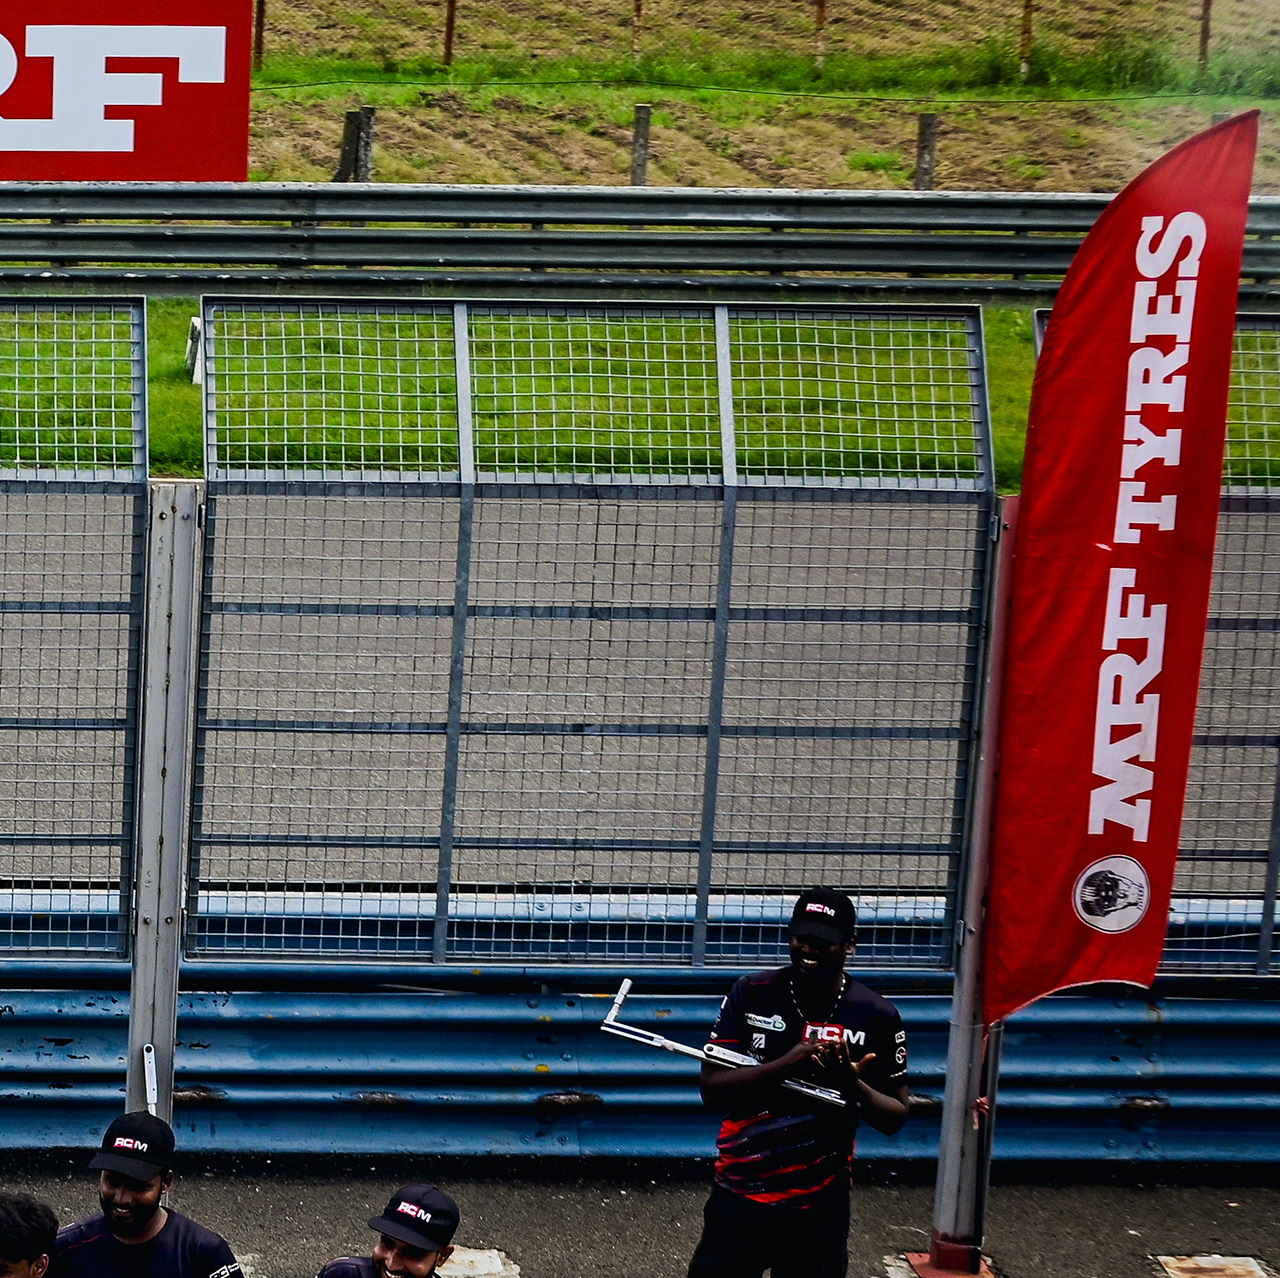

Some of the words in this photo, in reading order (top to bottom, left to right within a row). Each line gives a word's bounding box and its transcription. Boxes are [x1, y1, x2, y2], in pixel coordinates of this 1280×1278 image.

[1114, 210, 1208, 552] TYRES
[1087, 567, 1168, 843] MRF
[806, 903, 836, 917] RCM
[804, 1023, 866, 1046] RCM
[114, 1137, 148, 1152] RCM
[399, 1201, 432, 1223] RCM
